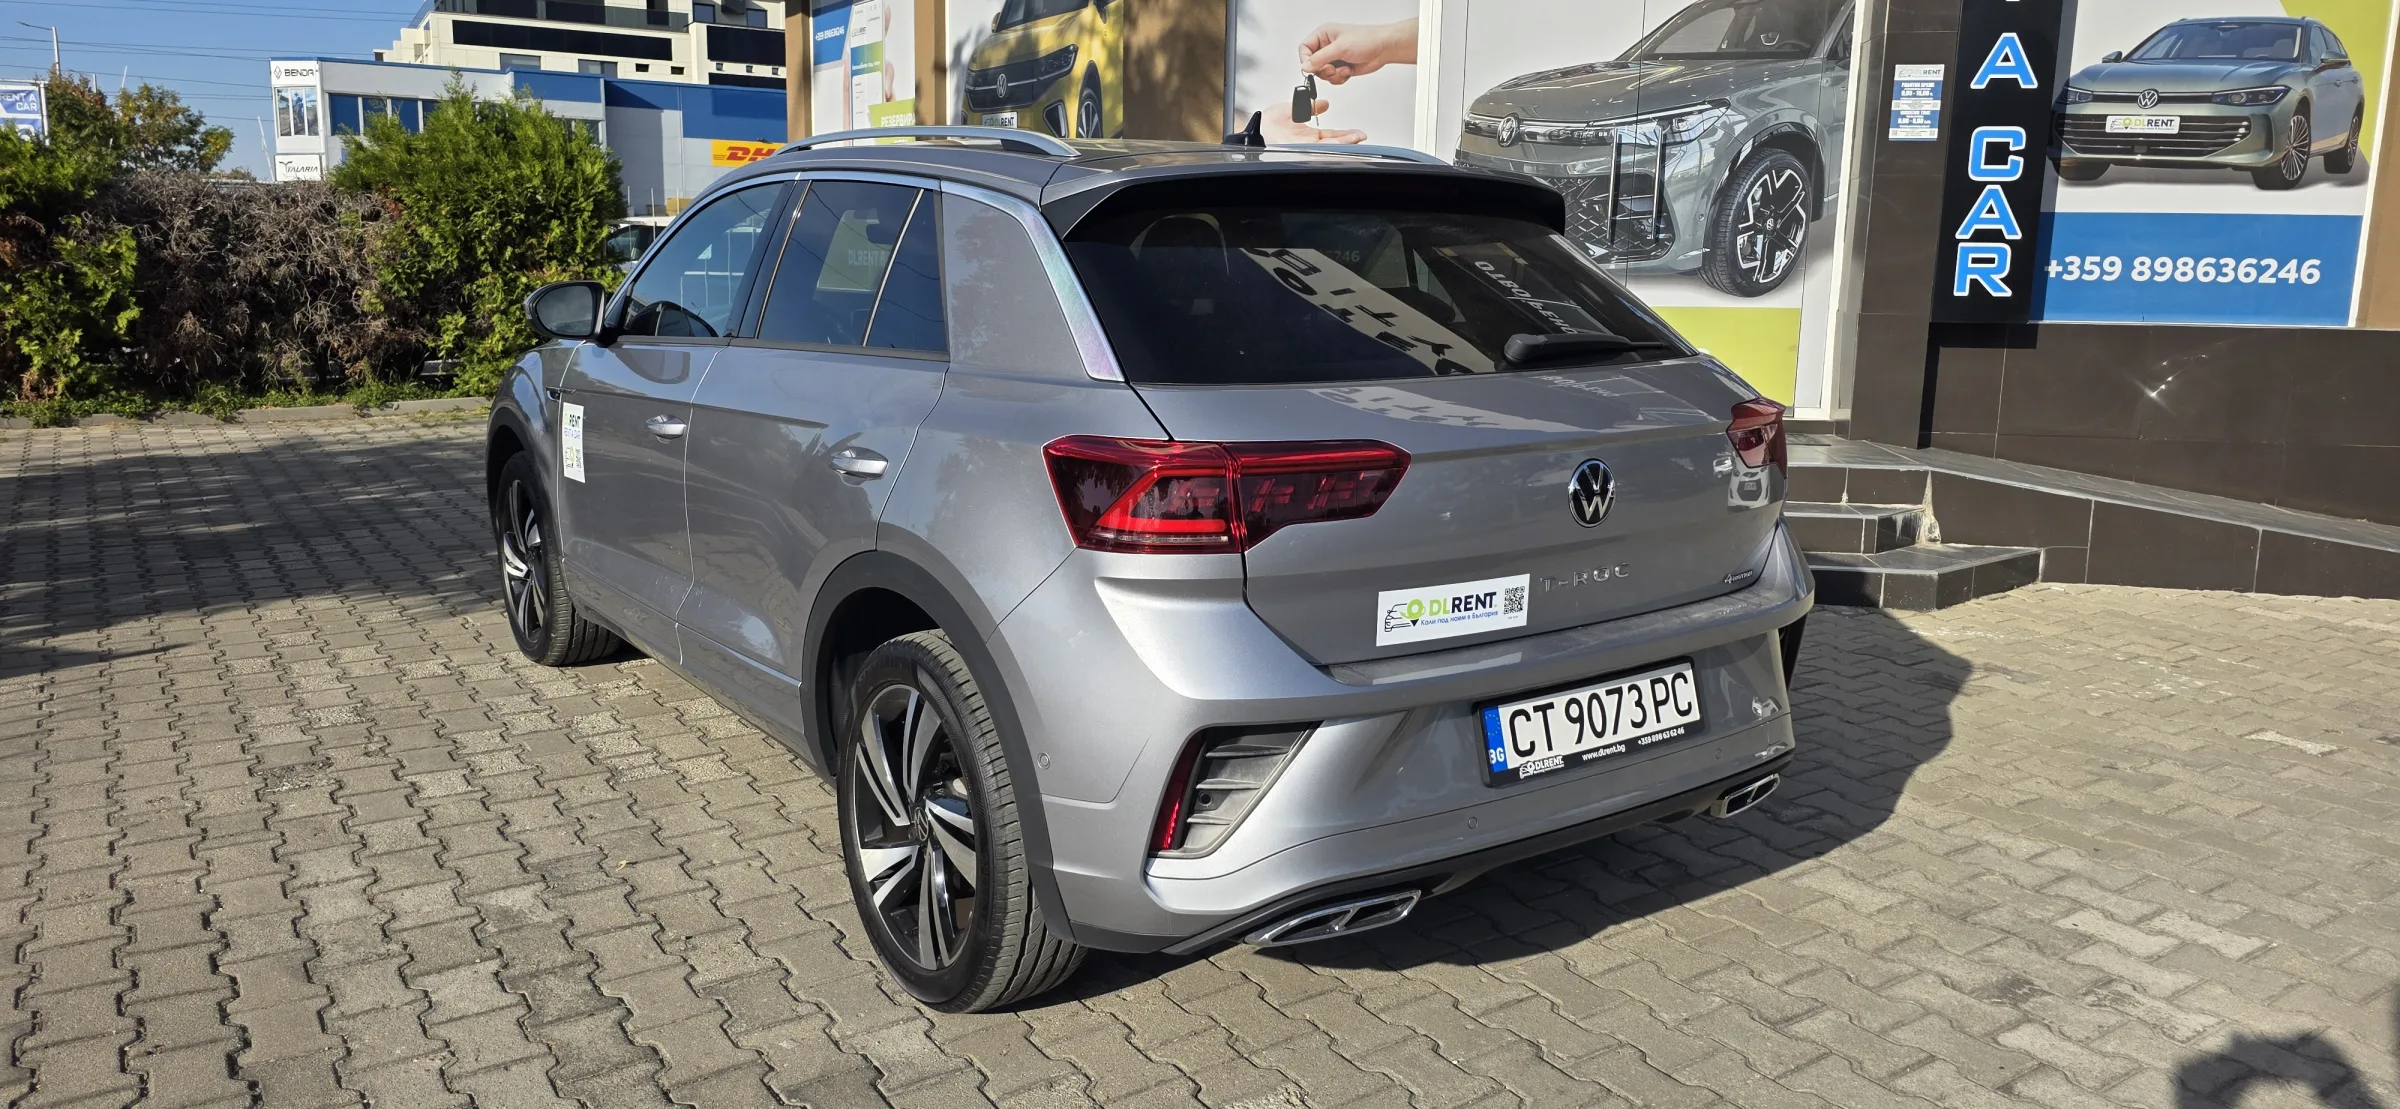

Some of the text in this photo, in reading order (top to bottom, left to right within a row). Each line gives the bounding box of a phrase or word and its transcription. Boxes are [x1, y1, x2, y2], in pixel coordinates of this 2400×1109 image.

[284, 68, 314, 76] BENDA
[29, 93, 37, 102] A
[16, 102, 38, 112] CAR
[725, 146, 776, 161] DH
[1952, 125, 2026, 297] CAR
[2045, 256, 2321, 284] +359 898636246
[1540, 563, 1630, 592] T-ROC
[1437, 616, 1449, 624] под
[1509, 672, 1693, 758] CT 9073 PC
[1638, 736, 1651, 745] +359
[1581, 743, 1626, 761] www.dlrent.bg
